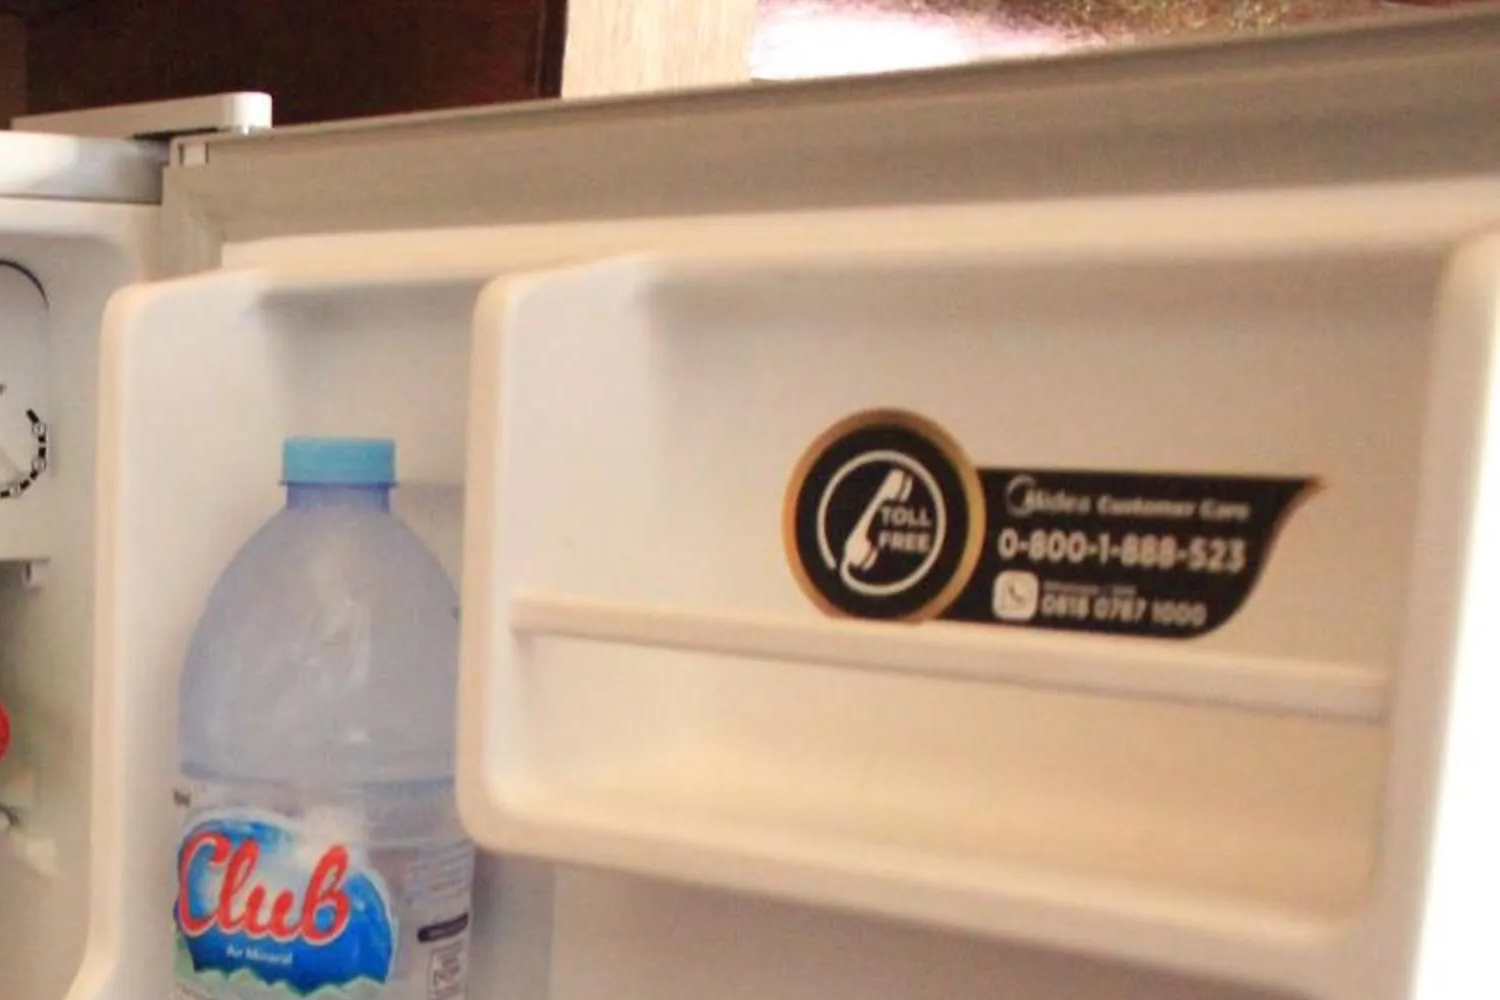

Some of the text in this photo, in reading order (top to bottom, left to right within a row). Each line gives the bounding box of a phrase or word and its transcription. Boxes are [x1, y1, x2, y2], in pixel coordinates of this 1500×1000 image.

[881, 505, 931, 527] TOLL
[879, 530, 931, 553] FREE
[179, 831, 349, 944] Club
